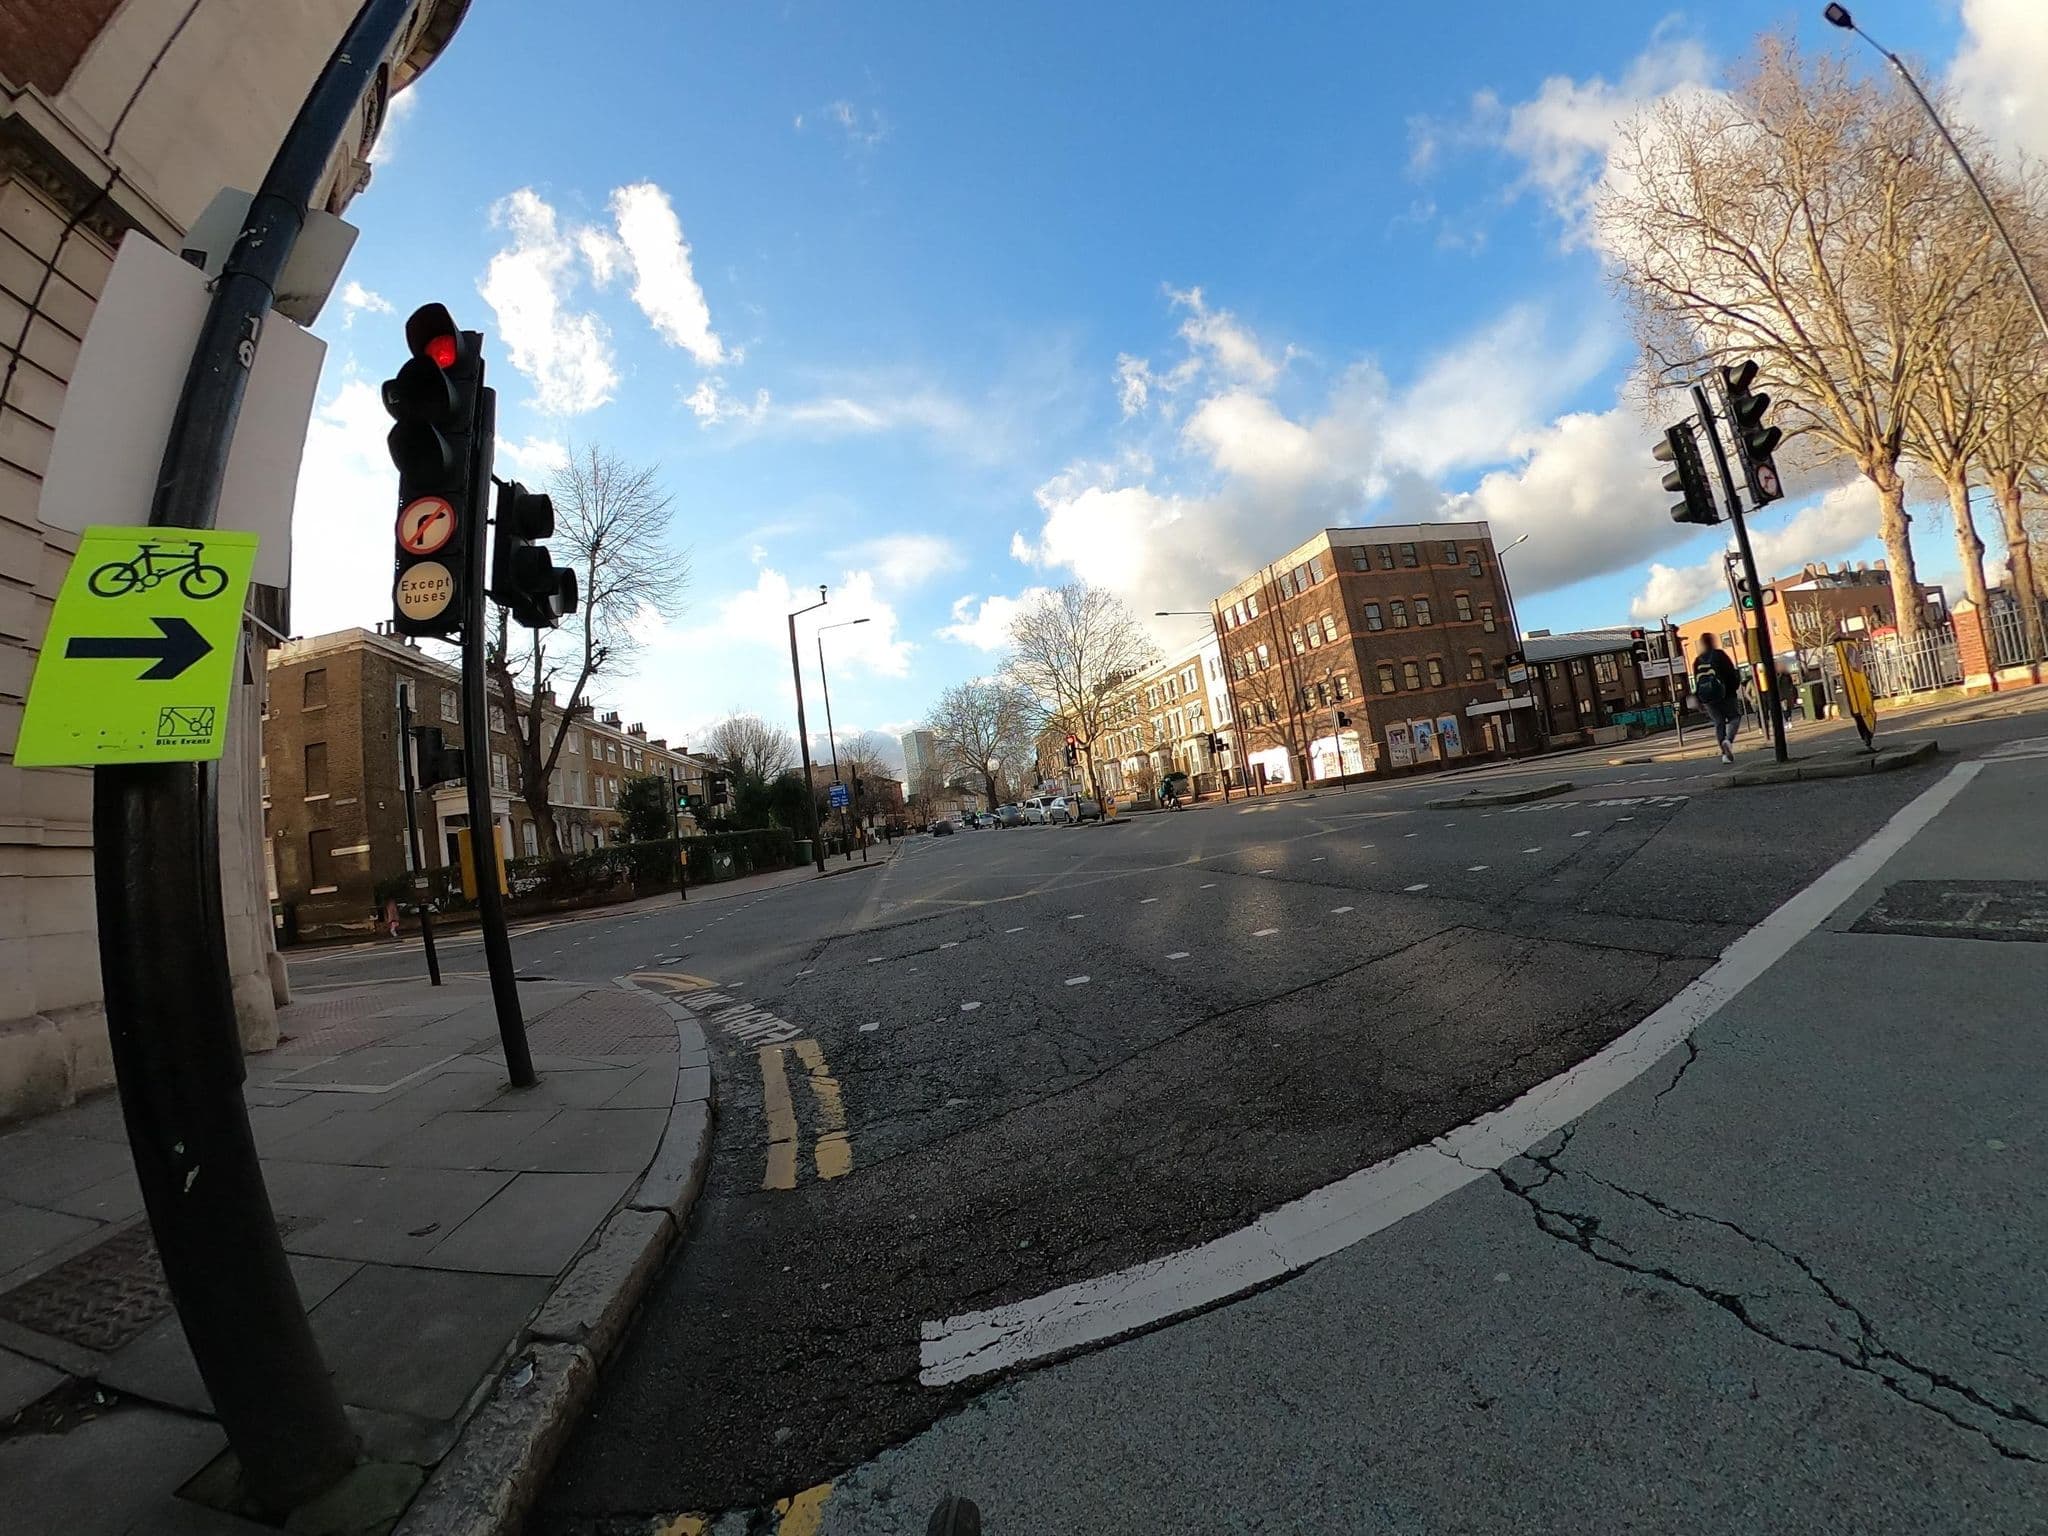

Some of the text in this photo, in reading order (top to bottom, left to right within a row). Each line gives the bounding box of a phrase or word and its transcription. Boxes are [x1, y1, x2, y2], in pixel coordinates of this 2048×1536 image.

[401, 576, 449, 591] Except
[405, 591, 446, 604] buses
[156, 738, 177, 746] Bike
